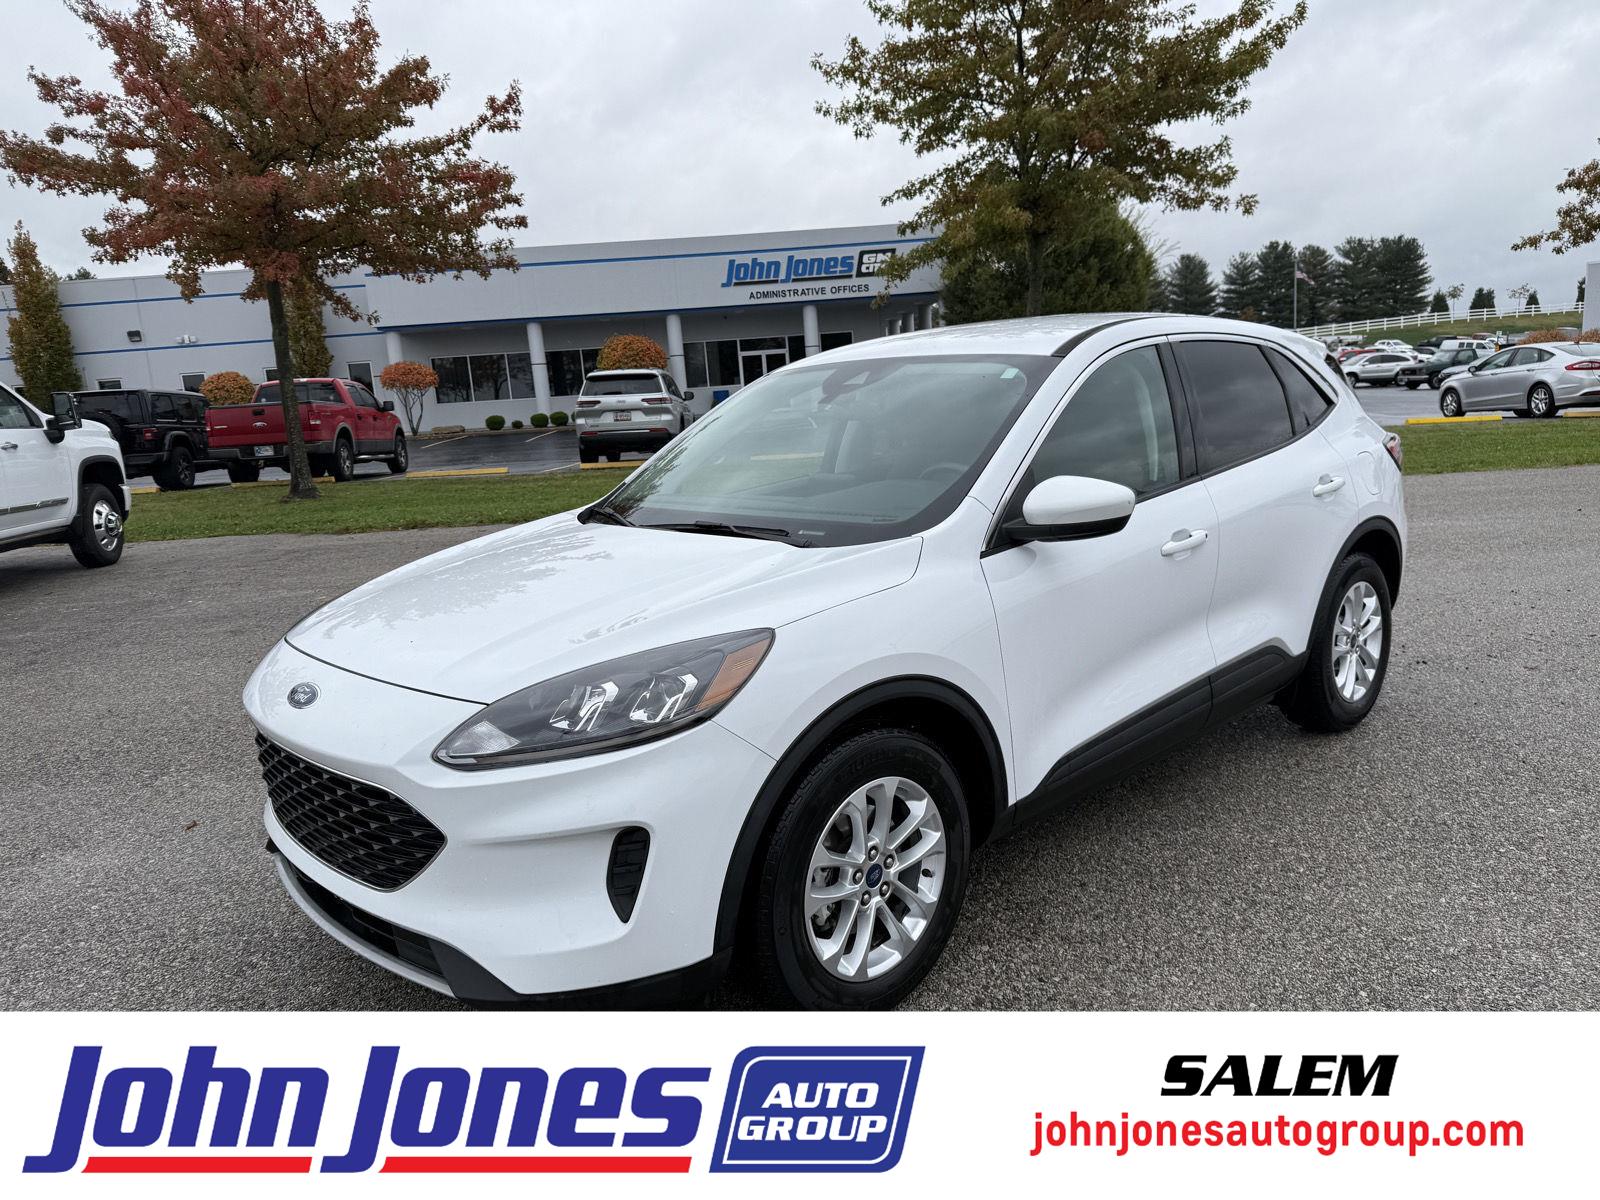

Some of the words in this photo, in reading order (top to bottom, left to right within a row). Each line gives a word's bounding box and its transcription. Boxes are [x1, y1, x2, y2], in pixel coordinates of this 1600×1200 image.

[721, 257, 781, 288] John
[780, 255, 854, 284] Jones
[749, 286, 826, 300] ADMINISTRATIVE
[830, 284, 870, 295] OFFICES
